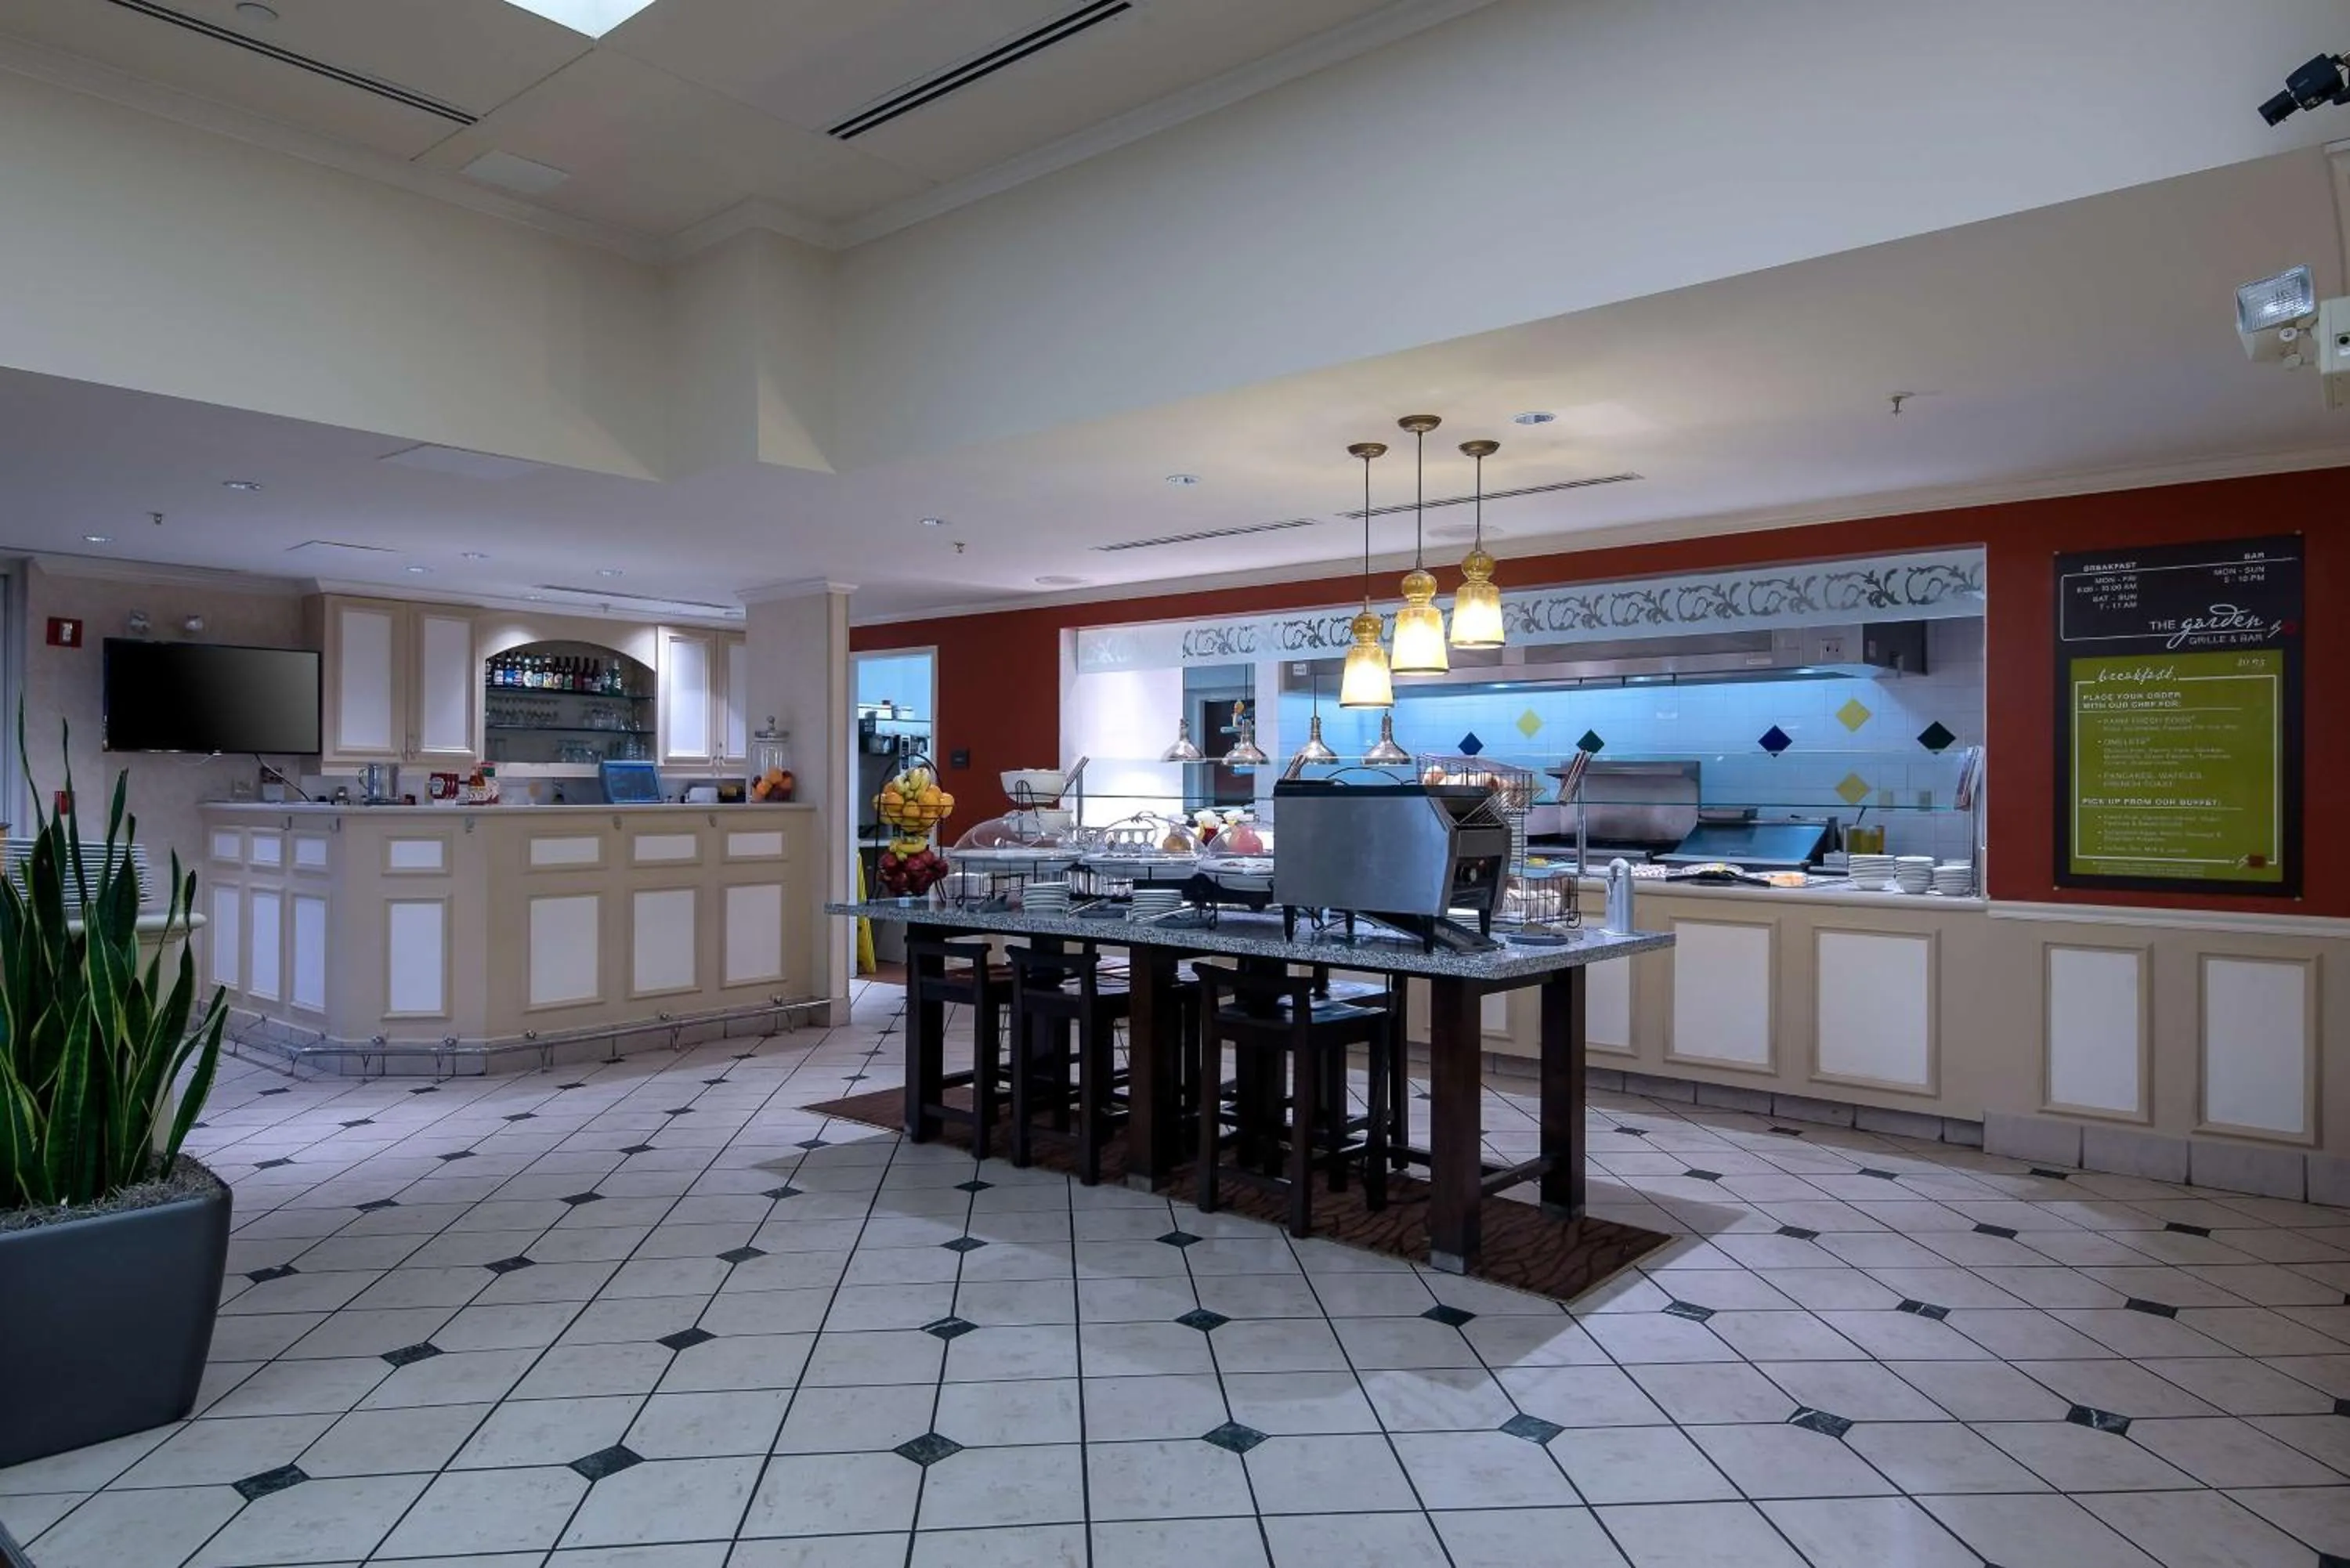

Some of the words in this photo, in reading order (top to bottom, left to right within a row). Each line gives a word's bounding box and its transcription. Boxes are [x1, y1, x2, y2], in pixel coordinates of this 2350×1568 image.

[2083, 562, 2137, 573] BREAKFAST
[2149, 620, 2176, 631] THE
[2166, 604, 2264, 649] garden
[2189, 635, 2227, 645] GRILLE
[2240, 634, 2262, 643] BAR
